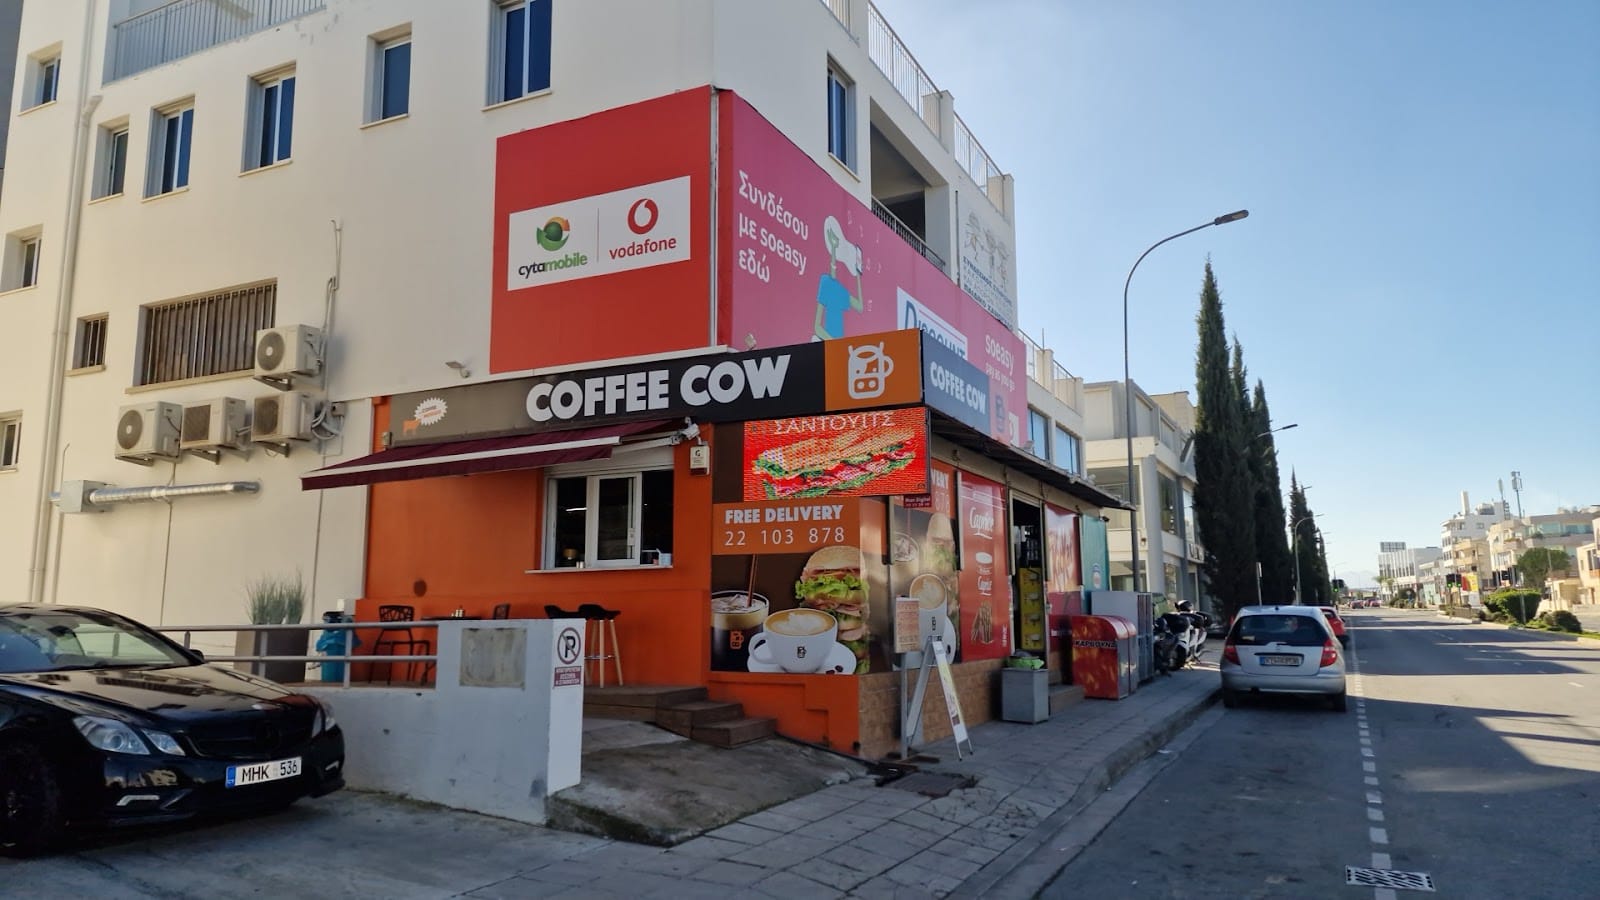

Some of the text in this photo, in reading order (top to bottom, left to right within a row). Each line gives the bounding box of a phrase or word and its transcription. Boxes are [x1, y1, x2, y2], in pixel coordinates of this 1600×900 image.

[739, 170, 808, 240] Συνδέσου
[609, 238, 677, 260] vodafone
[739, 213, 807, 275] με soeasy
[518, 252, 588, 279] cytamobile
[739, 248, 770, 283] εδώ
[985, 334, 1014, 376] soeasy
[526, 354, 791, 422] COFFEE COW
[930, 361, 986, 414] COFFEE COW
[774, 411, 896, 434] ΣΑΝΤΟΥΙΤΣ
[725, 505, 844, 524] FREE DELIVERY
[725, 527, 845, 546] 22 103 878
[242, 760, 297, 782] MHK 536
